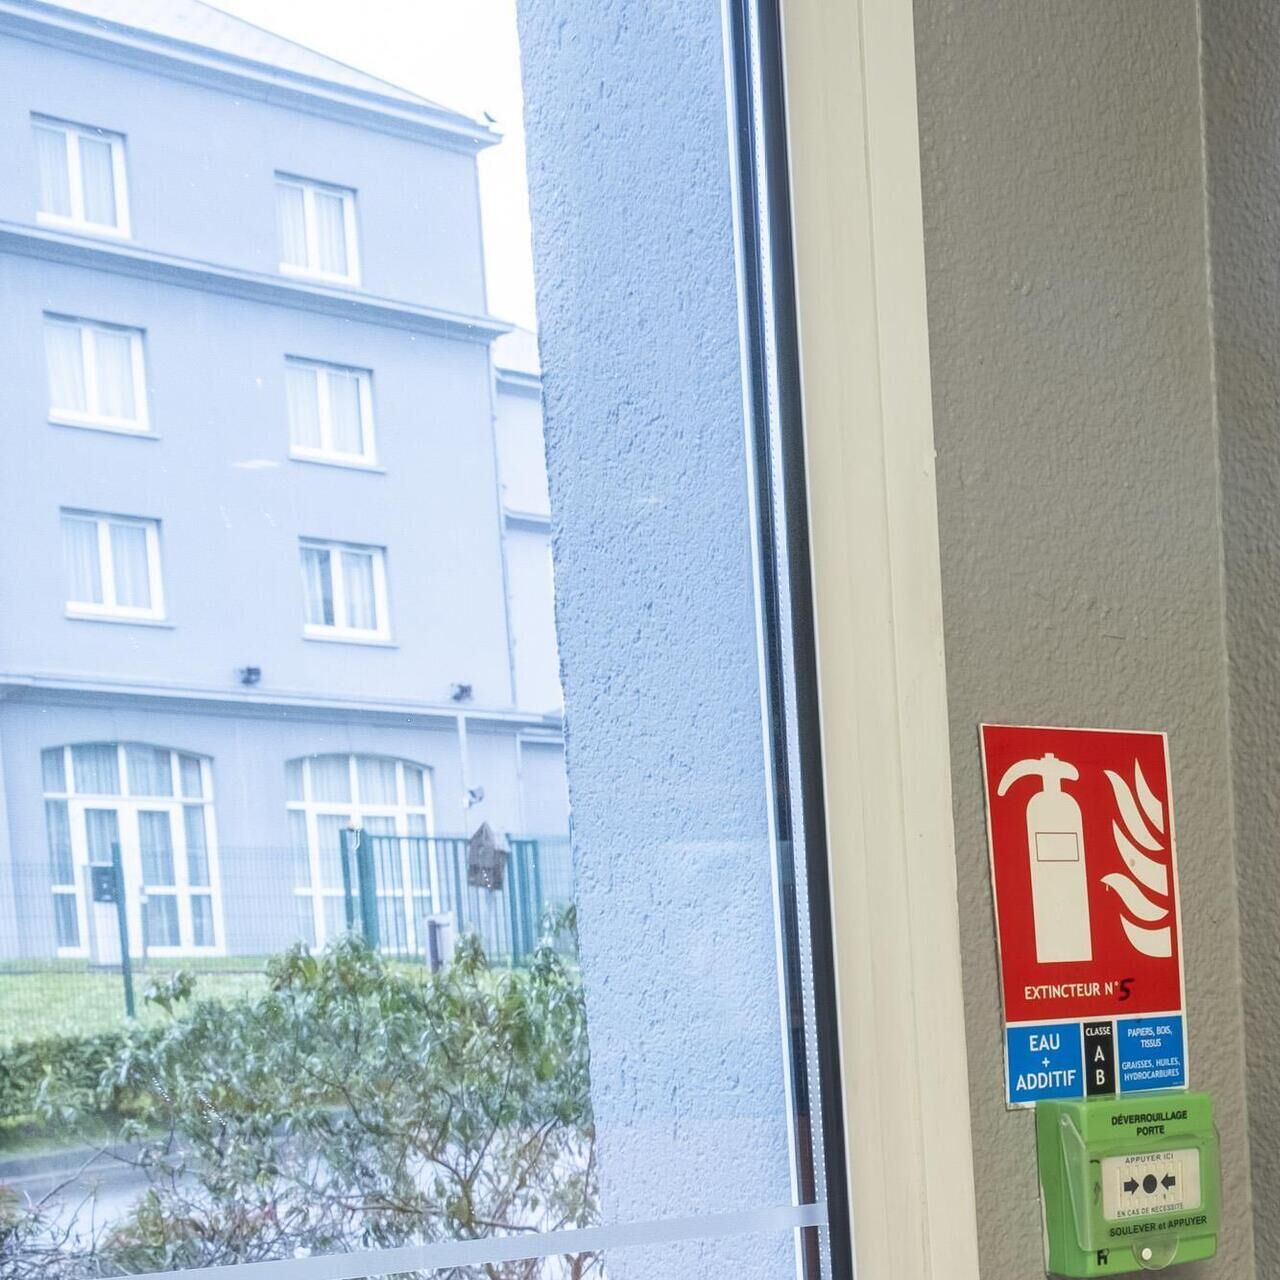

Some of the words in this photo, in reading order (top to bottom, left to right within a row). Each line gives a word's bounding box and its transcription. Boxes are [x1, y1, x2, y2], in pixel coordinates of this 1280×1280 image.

[1024, 982, 1100, 1000] EXTINCTEUR
[1085, 1026, 1111, 1037] CLASSE
[1029, 1033, 1060, 1052] EAU
[1141, 1038, 1161, 1048] TISSUS
[1094, 1045, 1105, 1062] A
[1016, 1069, 1076, 1091] ADDITIF
[1096, 1069, 1105, 1086] B
[1112, 1110, 1188, 1126] DÉVERROUILLAGE
[1136, 1125, 1165, 1136] PORTE
[1125, 1154, 1161, 1164] APPUYER
[1109, 1222, 1156, 1237] SOULEVER
[1168, 1215, 1207, 1229] APPUYER
